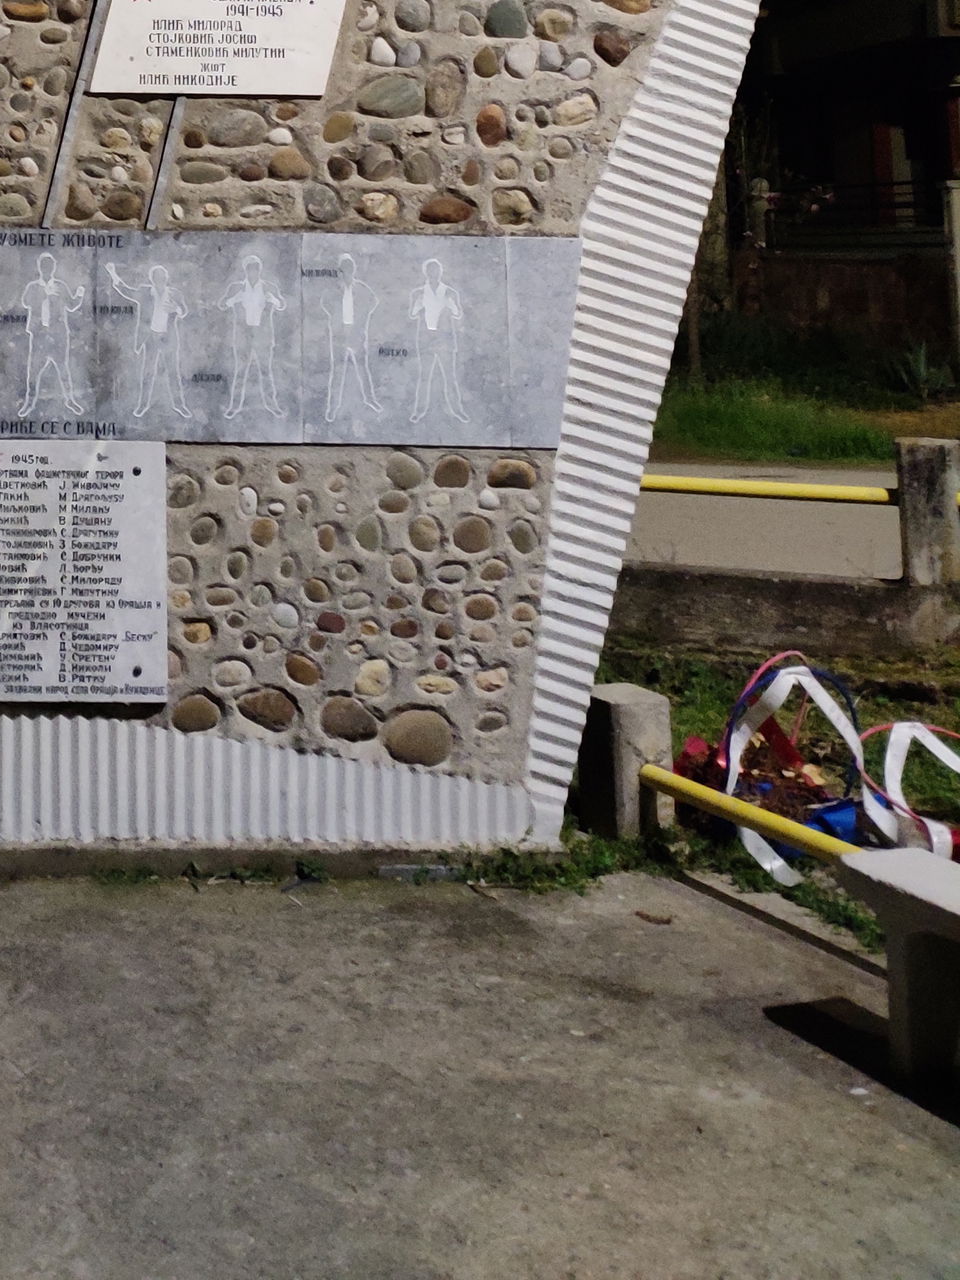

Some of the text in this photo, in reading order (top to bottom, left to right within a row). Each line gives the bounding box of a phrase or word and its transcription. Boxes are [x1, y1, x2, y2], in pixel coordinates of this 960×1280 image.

[188, 21, 242, 31] МИЛОРАД
[62, 233, 124, 248] ЖИВОТЕ
[41, 422, 58, 435] СЕ
[63, 422, 71, 435] С
[76, 422, 116, 437] ВАМА
